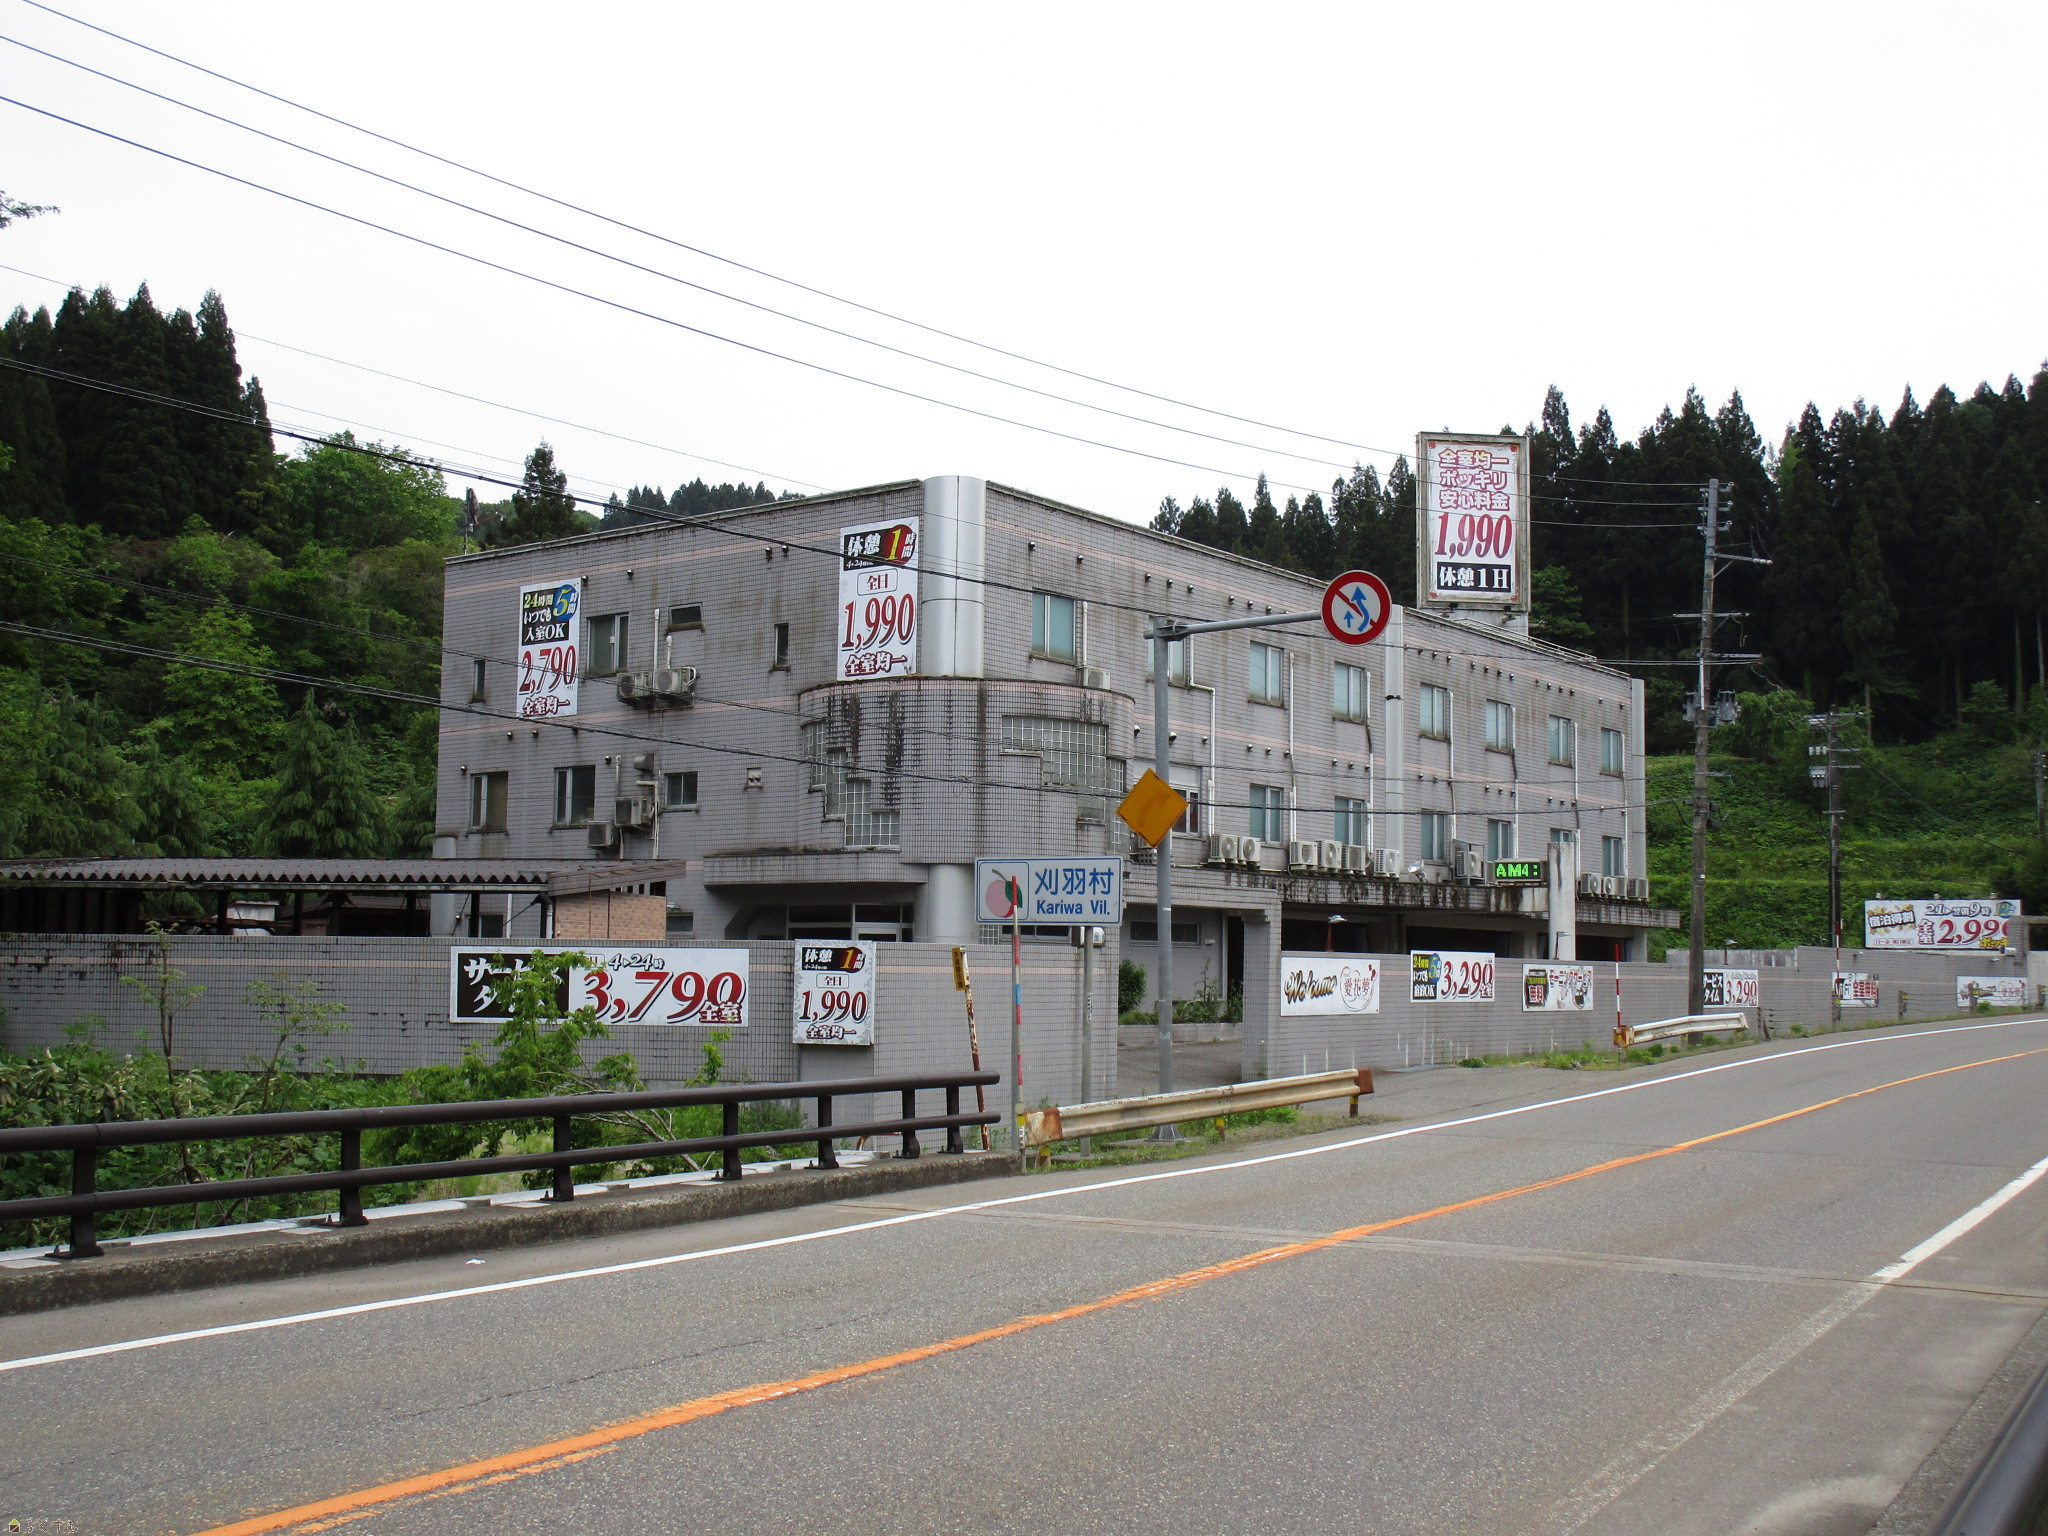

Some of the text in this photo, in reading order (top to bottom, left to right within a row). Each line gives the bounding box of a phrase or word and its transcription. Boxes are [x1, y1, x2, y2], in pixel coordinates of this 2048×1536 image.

[1438, 448, 1510, 469] 全室均一
[1439, 470, 1508, 490] ポッキリ
[1439, 489, 1510, 511] 安心料金
[847, 533, 881, 557] 休憩
[1434, 512, 1513, 559] 1,990
[867, 573, 889, 592] 全日
[524, 593, 554, 609] 24時間
[523, 607, 552, 625] いつでも
[842, 593, 915, 651] 1,990
[524, 622, 567, 643] 入室OK
[518, 645, 577, 696] 2,790
[845, 652, 908, 677] 全室均一
[523, 695, 571, 717] 全室均一
[1034, 867, 1114, 896] 刈羽村
[1036, 899, 1110, 916] Kariwa Vil.
[804, 948, 833, 963] 休憩
[824, 975, 842, 986] 全日
[1440, 961, 1493, 998] 3,290
[578, 971, 744, 1023] 3,790
[1725, 980, 1757, 1005] 3,290
[699, 1001, 743, 1024] 全室
[799, 990, 868, 1023] 1,990
[806, 1024, 857, 1040] 全室均一
